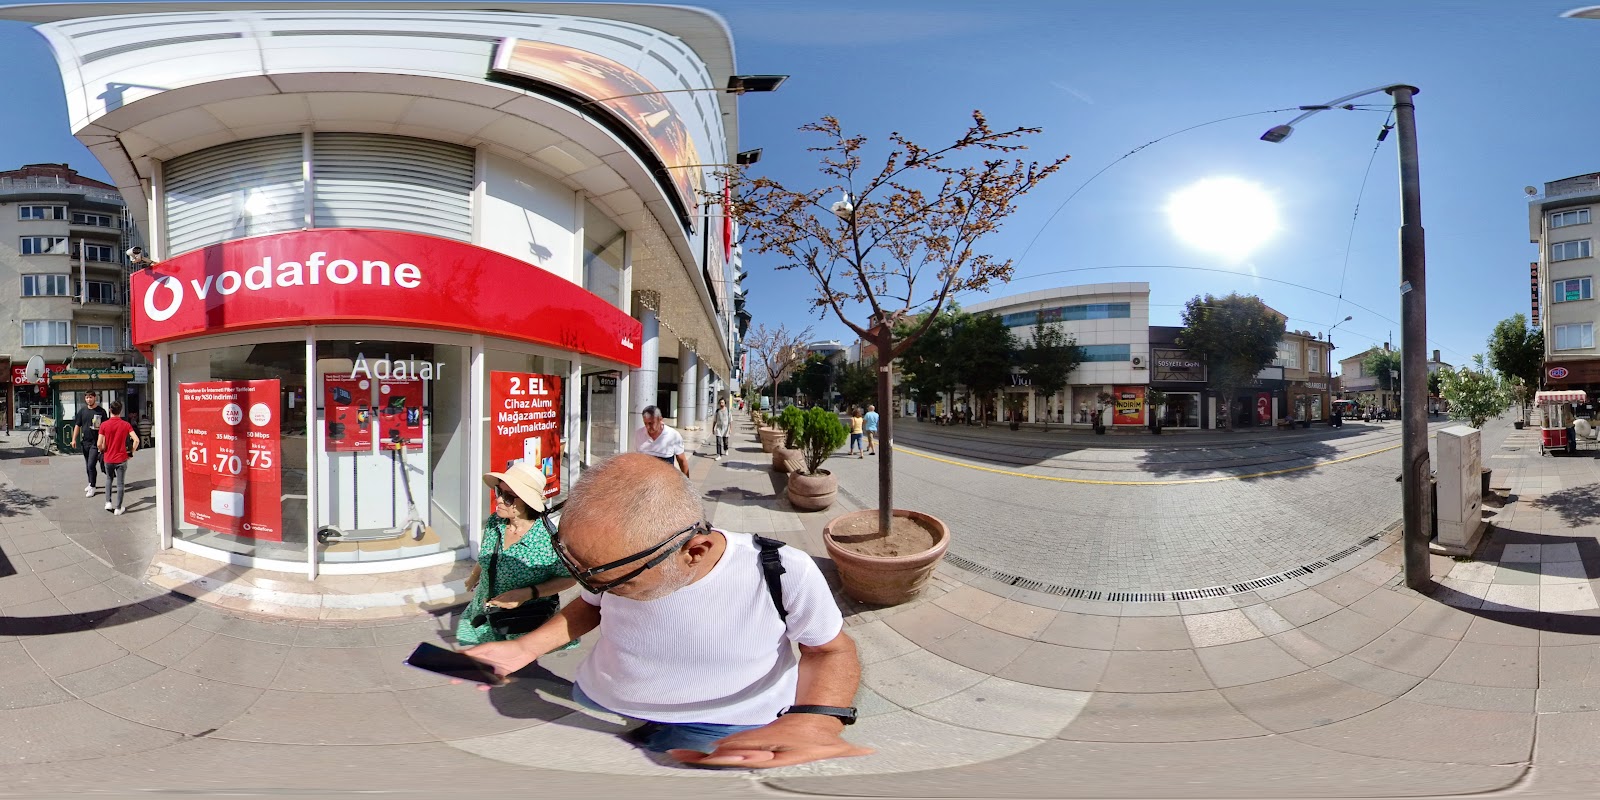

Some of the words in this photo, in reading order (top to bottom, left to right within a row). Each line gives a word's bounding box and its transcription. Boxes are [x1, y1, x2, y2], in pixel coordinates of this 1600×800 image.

[190, 252, 422, 300] vodafone
[350, 352, 446, 380] Adalar
[509, 377, 526, 395] 2.
[529, 378, 548, 395] EL
[504, 398, 530, 409] Cihaz
[531, 399, 552, 408] Alımı
[498, 409, 556, 423] Mağazamızda
[497, 420, 557, 437] Yapılmaktadır.
